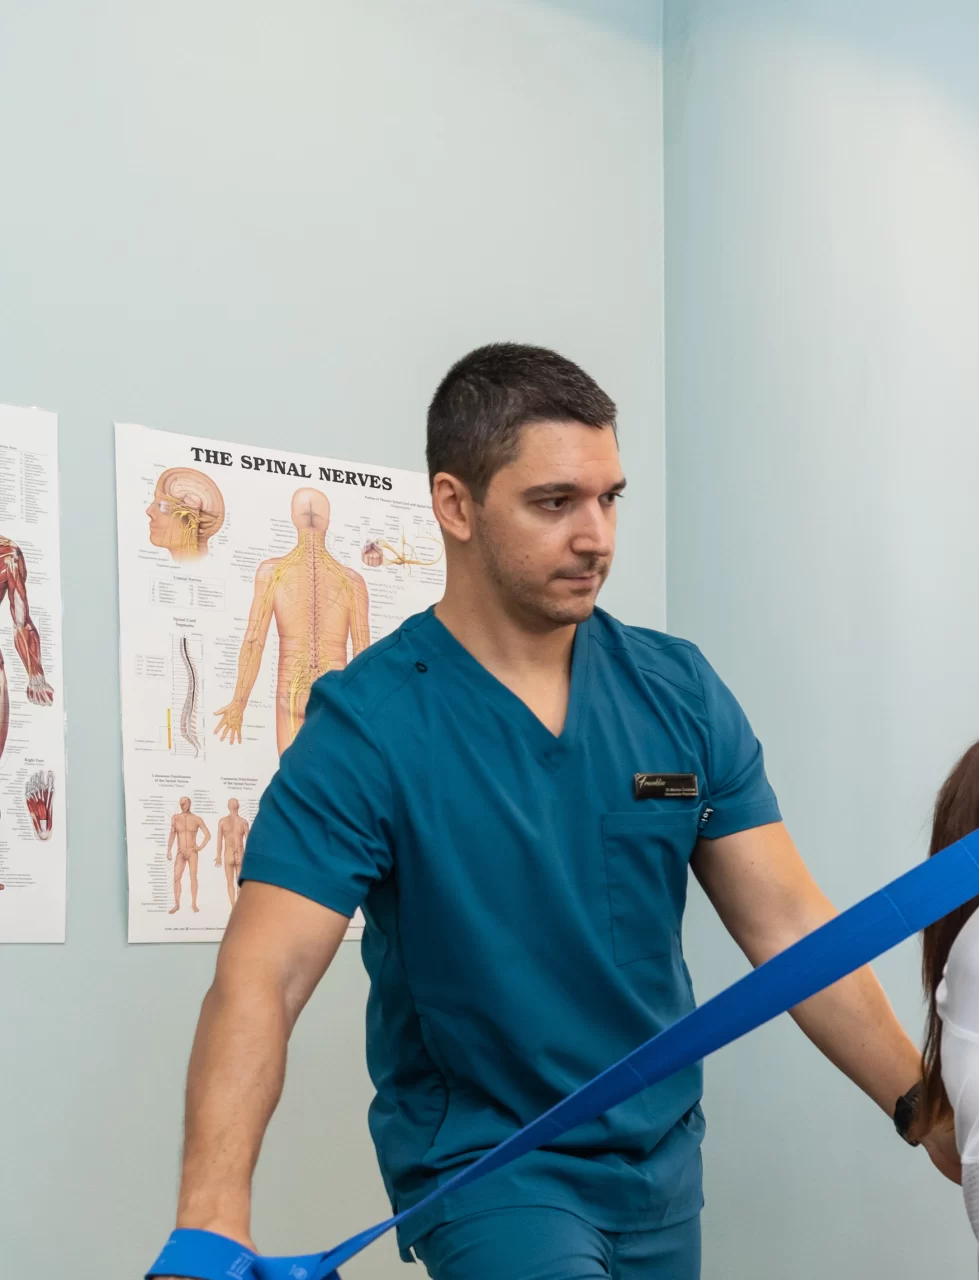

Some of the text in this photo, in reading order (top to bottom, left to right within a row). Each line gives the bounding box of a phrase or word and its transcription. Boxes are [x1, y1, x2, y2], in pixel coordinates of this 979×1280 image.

[190, 447, 393, 491] THE SPINAL NERVES
